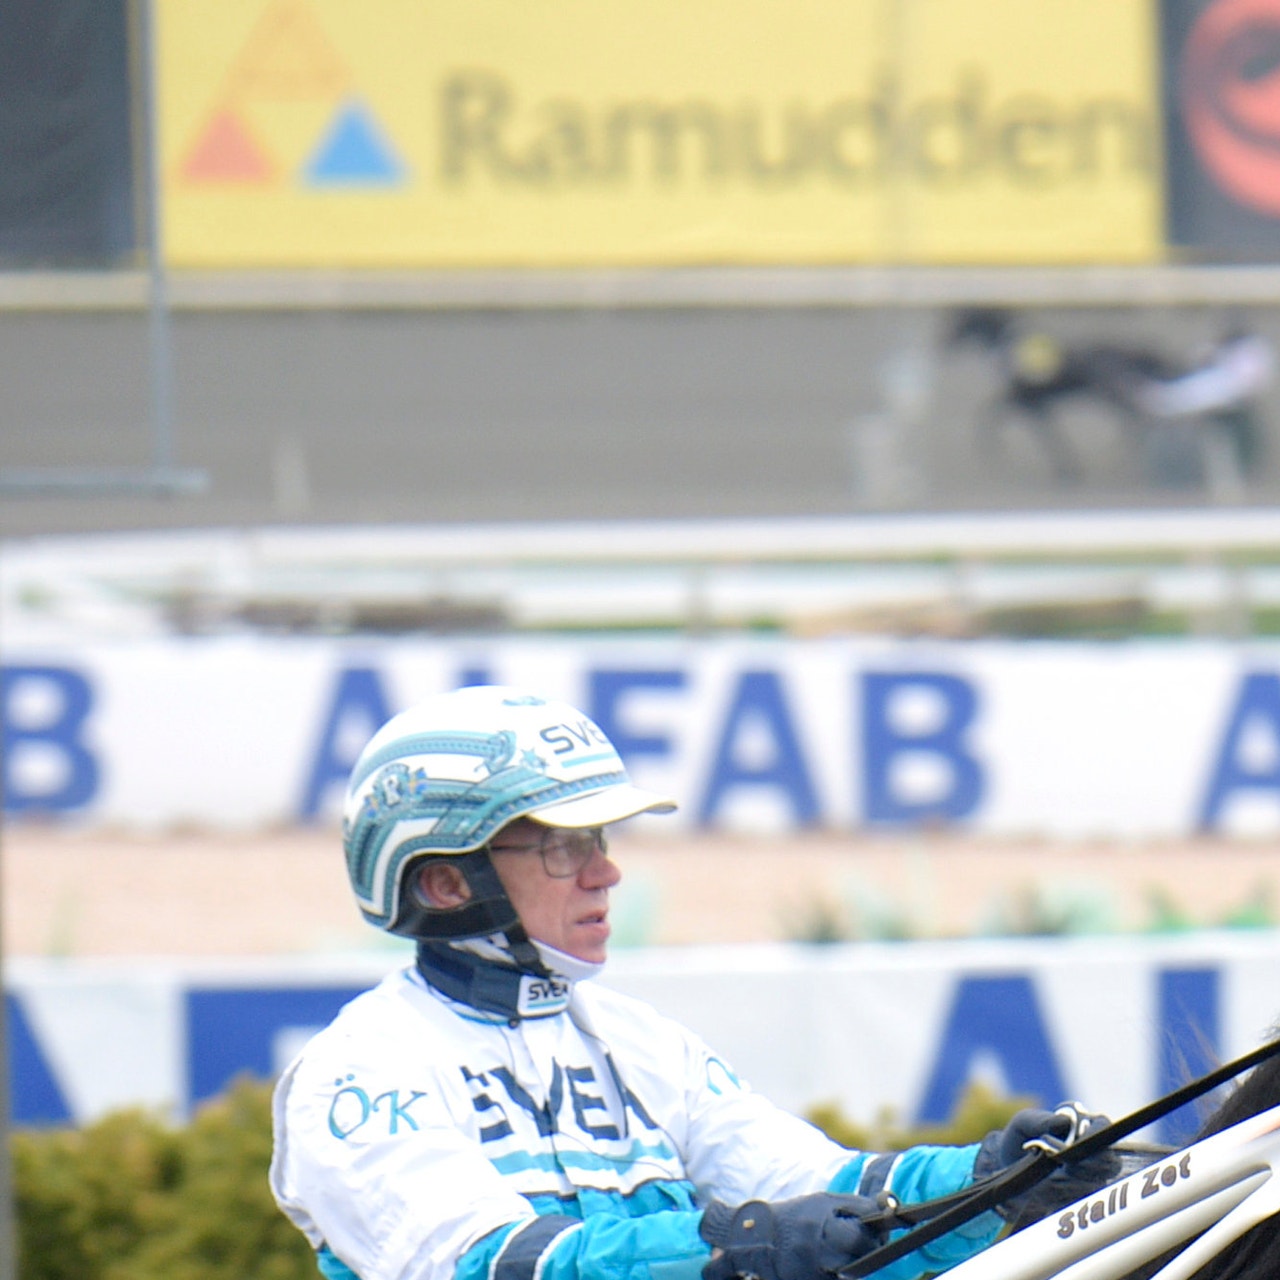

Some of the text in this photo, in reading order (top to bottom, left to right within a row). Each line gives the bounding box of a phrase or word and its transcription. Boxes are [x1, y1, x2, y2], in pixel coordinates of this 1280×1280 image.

[438, 66, 1158, 190] Ramudden
[528, 981, 569, 1001] SVEA
[327, 1073, 428, 1140] ÖK
[459, 1056, 660, 1144] SVEA
[1056, 1182, 1129, 1239] Stall
